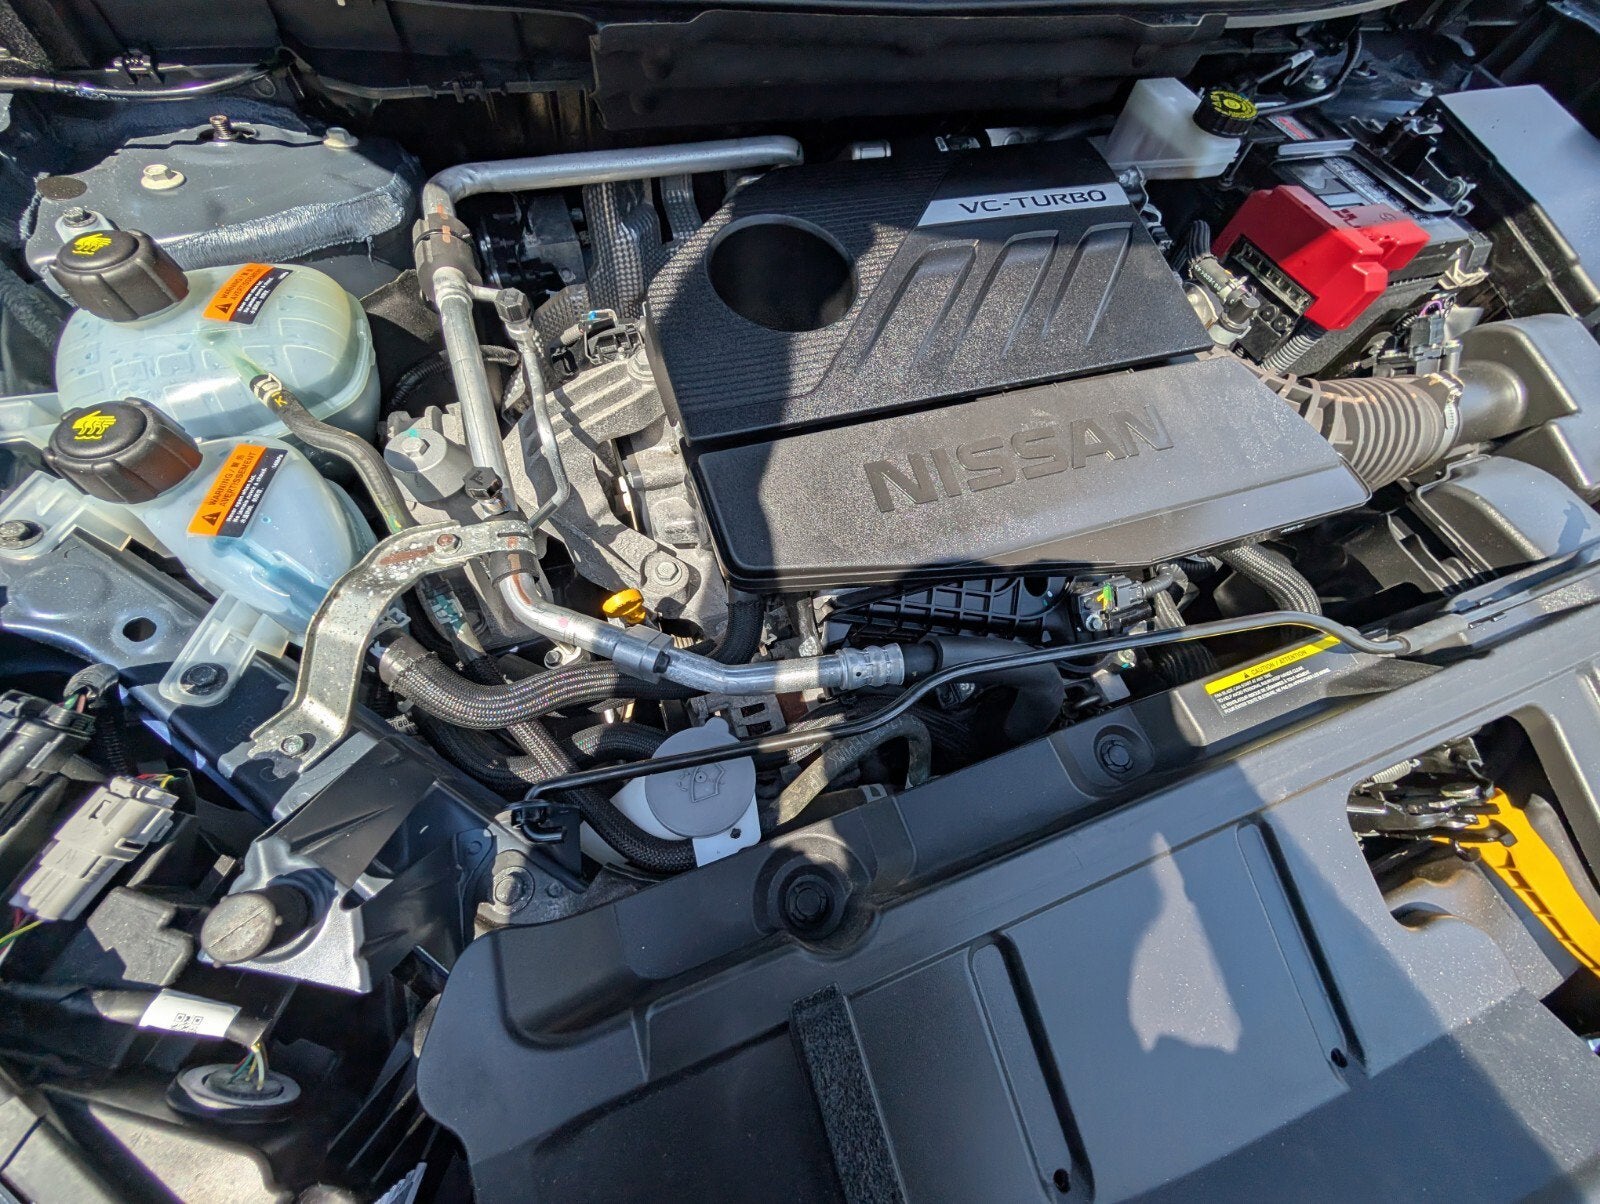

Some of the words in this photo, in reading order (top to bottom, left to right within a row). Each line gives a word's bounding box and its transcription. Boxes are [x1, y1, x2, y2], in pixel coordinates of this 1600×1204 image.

[958, 190, 1106, 214] VC-TURBO
[864, 404, 1174, 512] NISSAN
[208, 473, 233, 506] WARNING
[220, 452, 256, 507] AVERTISSEMENT
[1250, 662, 1276, 675] CAUTION
[1279, 650, 1307, 665] ATTENTION
